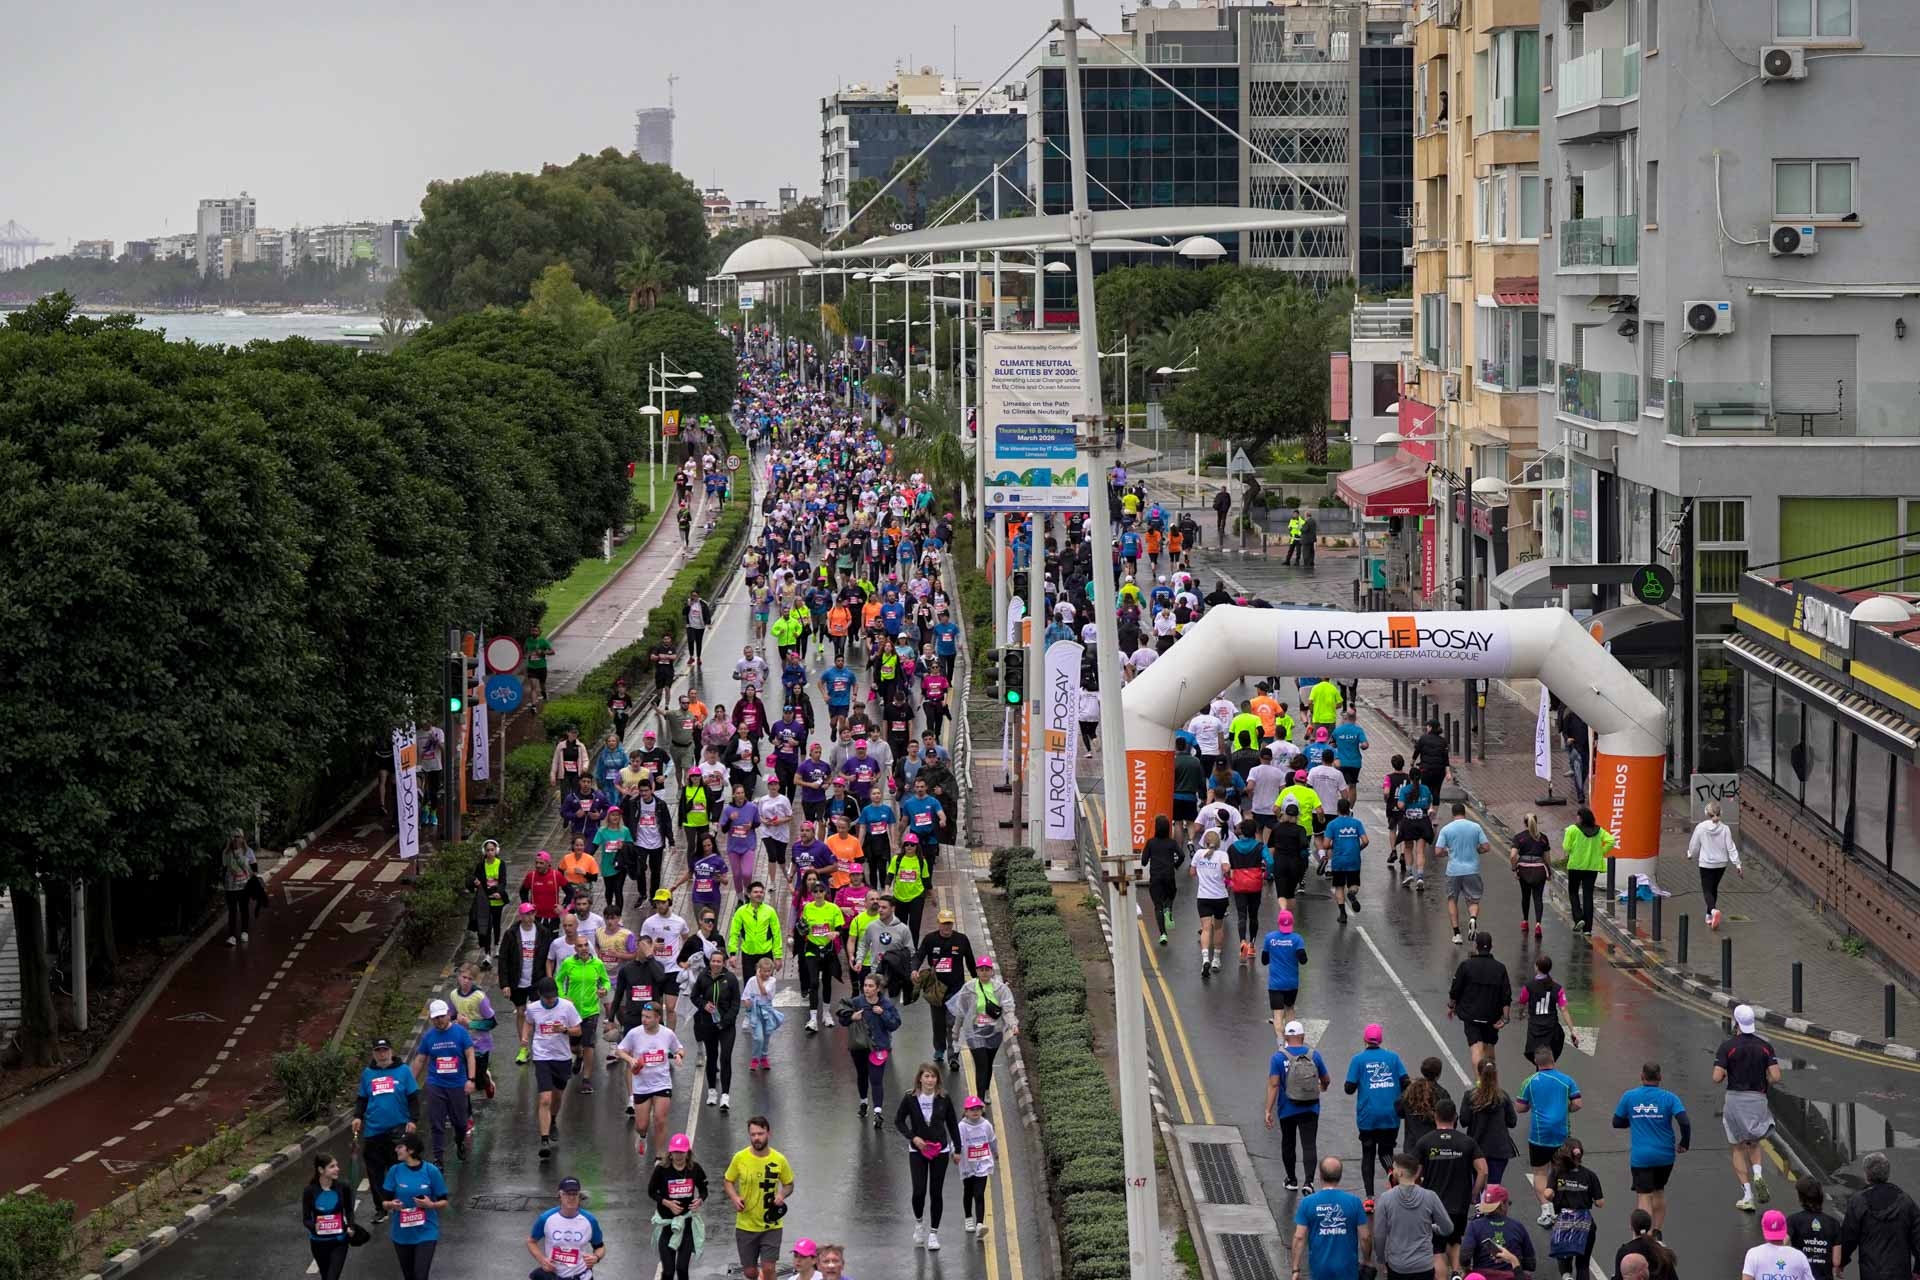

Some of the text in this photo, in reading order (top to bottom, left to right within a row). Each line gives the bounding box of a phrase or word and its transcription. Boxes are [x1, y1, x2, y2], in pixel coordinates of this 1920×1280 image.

[999, 359, 1073, 367] CLIMATE NEUTRAL
[994, 368, 1078, 376] BLUE CITIES BY 2030:
[728, 457, 738, 467] 50
[1294, 628, 1494, 651] LA ROCHE POSAY
[1326, 649, 1479, 661] LABORATOIRE DERMATOLOGIQUE
[1050, 668, 1069, 828] LA ROCHE POSAY
[1133, 758, 1147, 845] ANTHELIOS
[1610, 764, 1629, 850] ANTHELIOS
[1134, 1177, 1147, 1188] 47
[1803, 1237, 1828, 1246] wahoo
